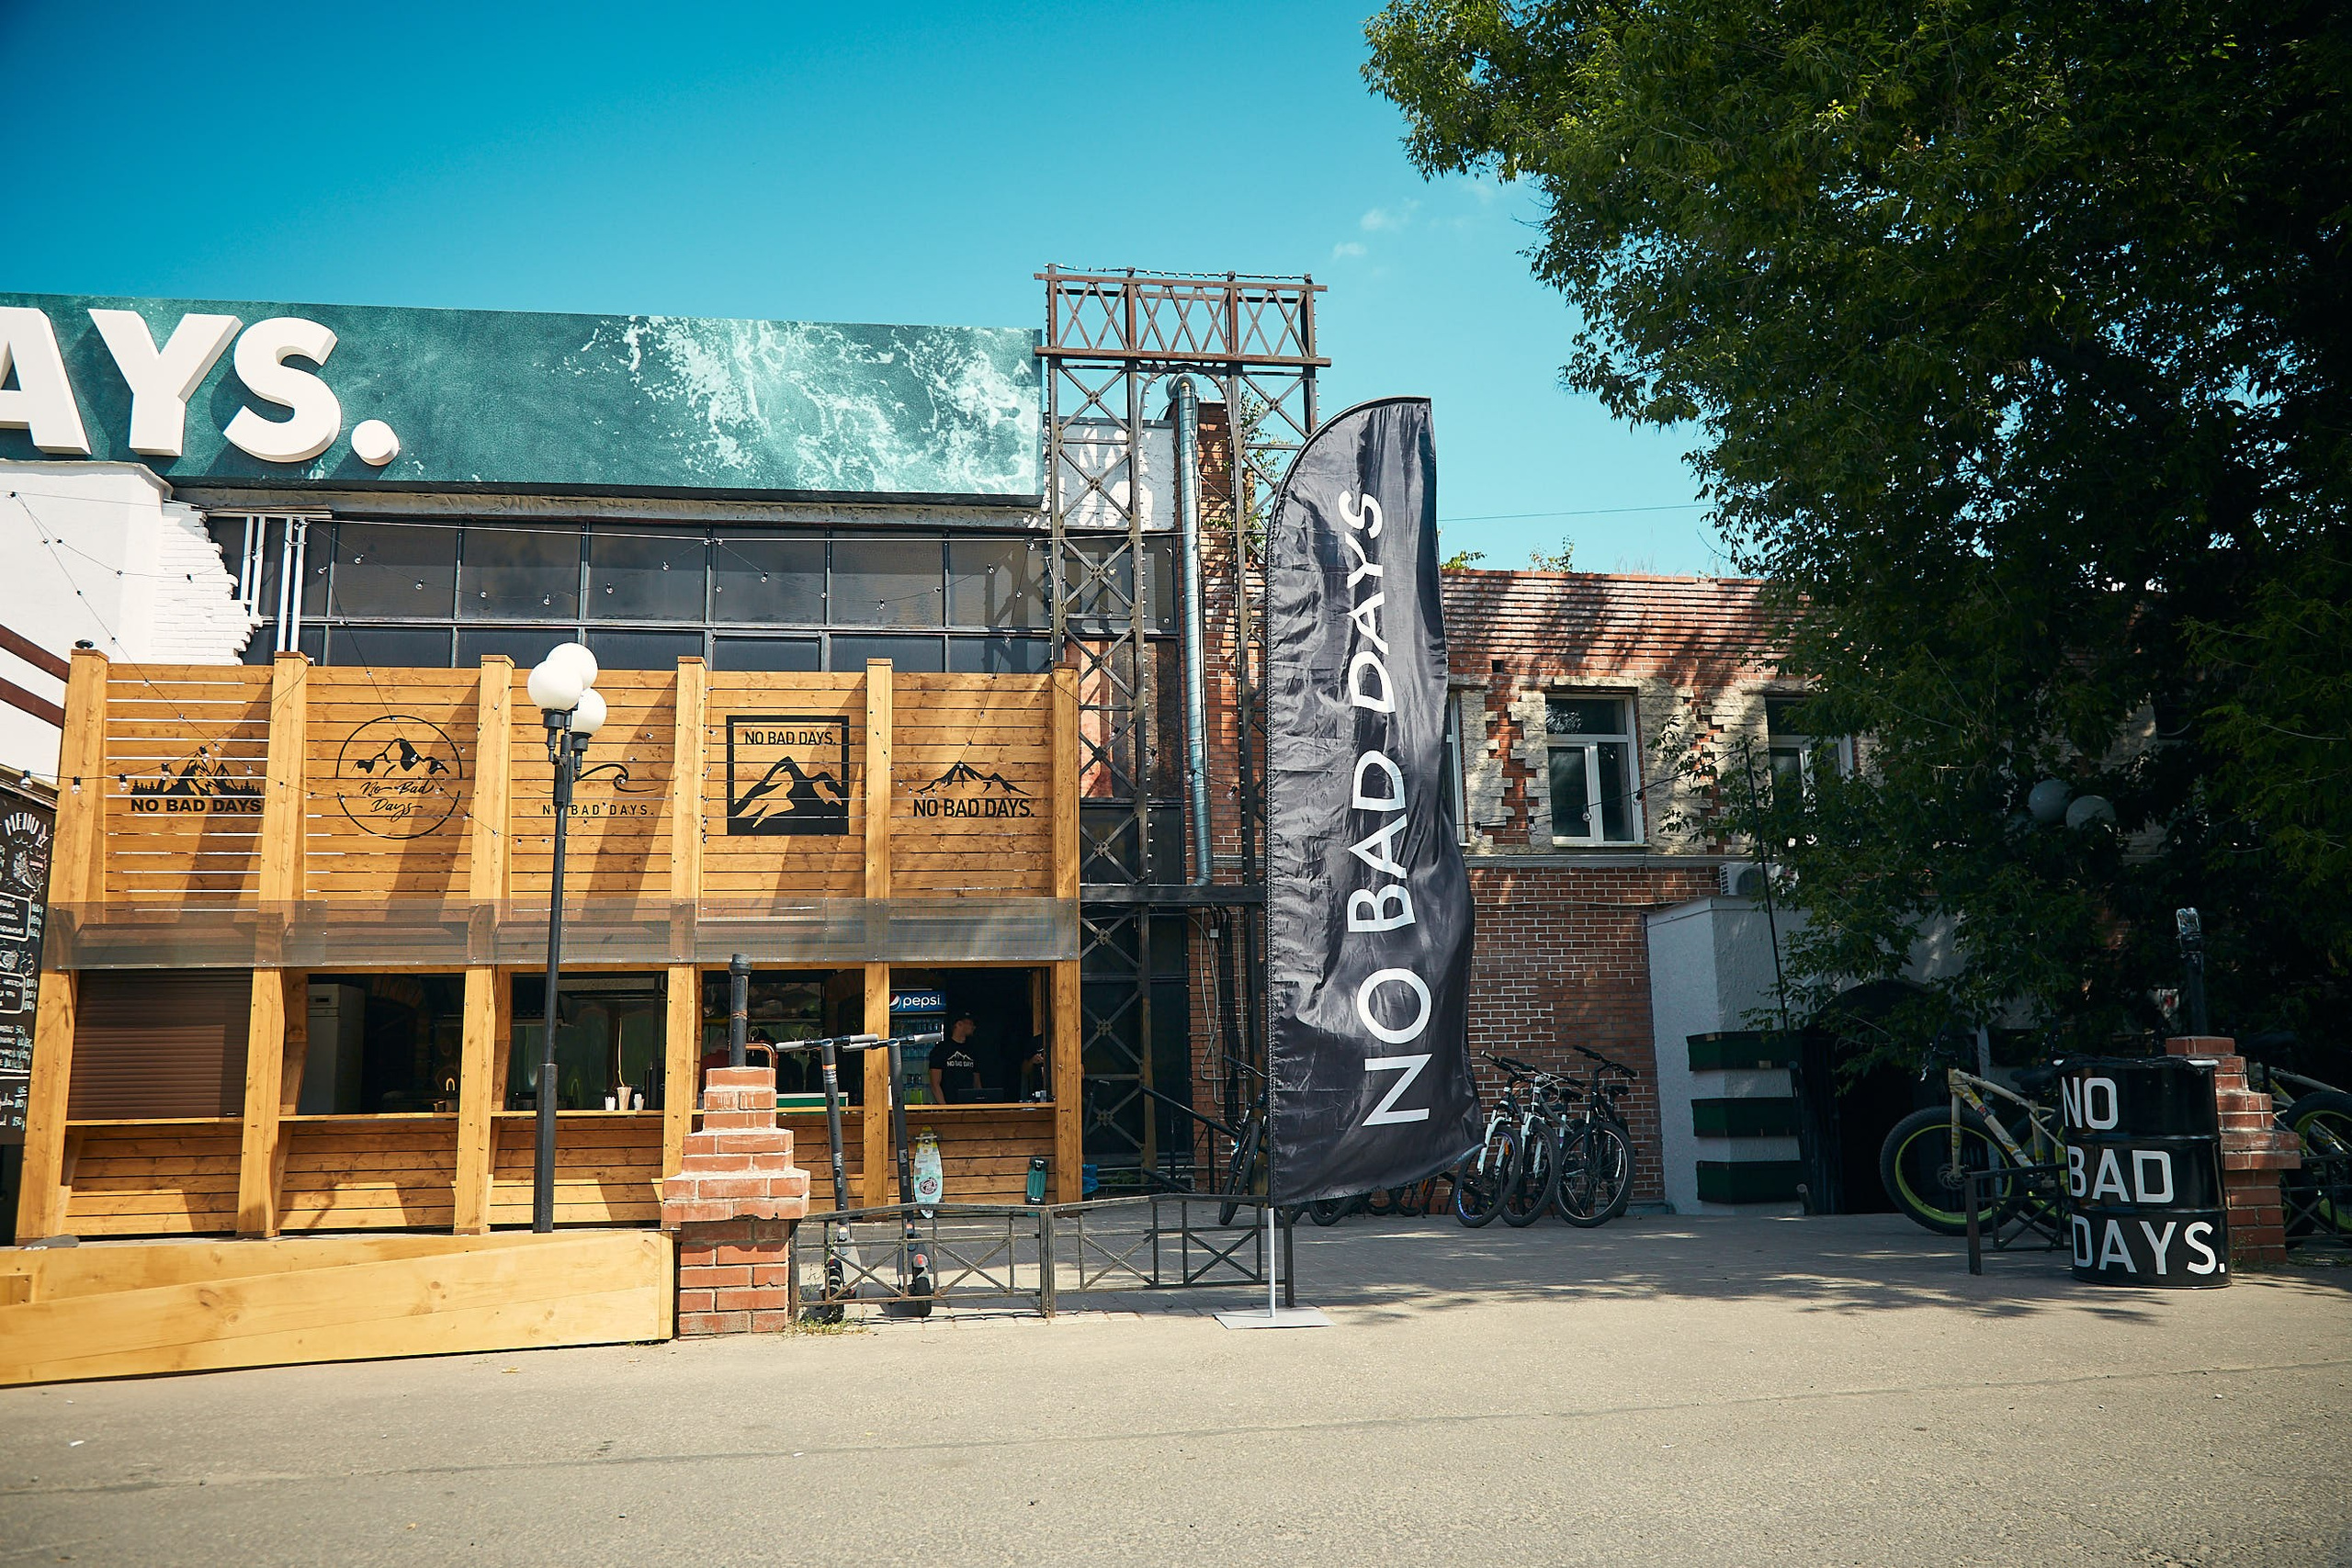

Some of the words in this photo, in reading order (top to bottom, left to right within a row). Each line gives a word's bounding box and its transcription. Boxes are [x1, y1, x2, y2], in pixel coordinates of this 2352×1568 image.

[1339, 491, 1396, 713] DAYS
[745, 731, 763, 745] NO
[768, 731, 795, 745] BAD
[799, 731, 837, 745] DAYS.
[360, 782, 392, 795] No
[394, 780, 435, 795] Bad
[130, 799, 159, 812] NO
[166, 799, 206, 812] BAD
[212, 799, 262, 812] DAYS
[370, 798, 423, 822] Days
[571, 805, 600, 815] BAD
[610, 805, 654, 815] DAYS.
[913, 798, 937, 817] NO
[944, 798, 979, 817] BAD
[985, 798, 1035, 818] DAYS.
[1347, 750, 1416, 933] BAD
[903, 994, 940, 1009] pepsi
[1357, 968, 1432, 1127] NO
[2061, 1077, 2119, 1130] NO
[2067, 1145, 2174, 1203] BAD
[2072, 1214, 2225, 1275] DAYS.
